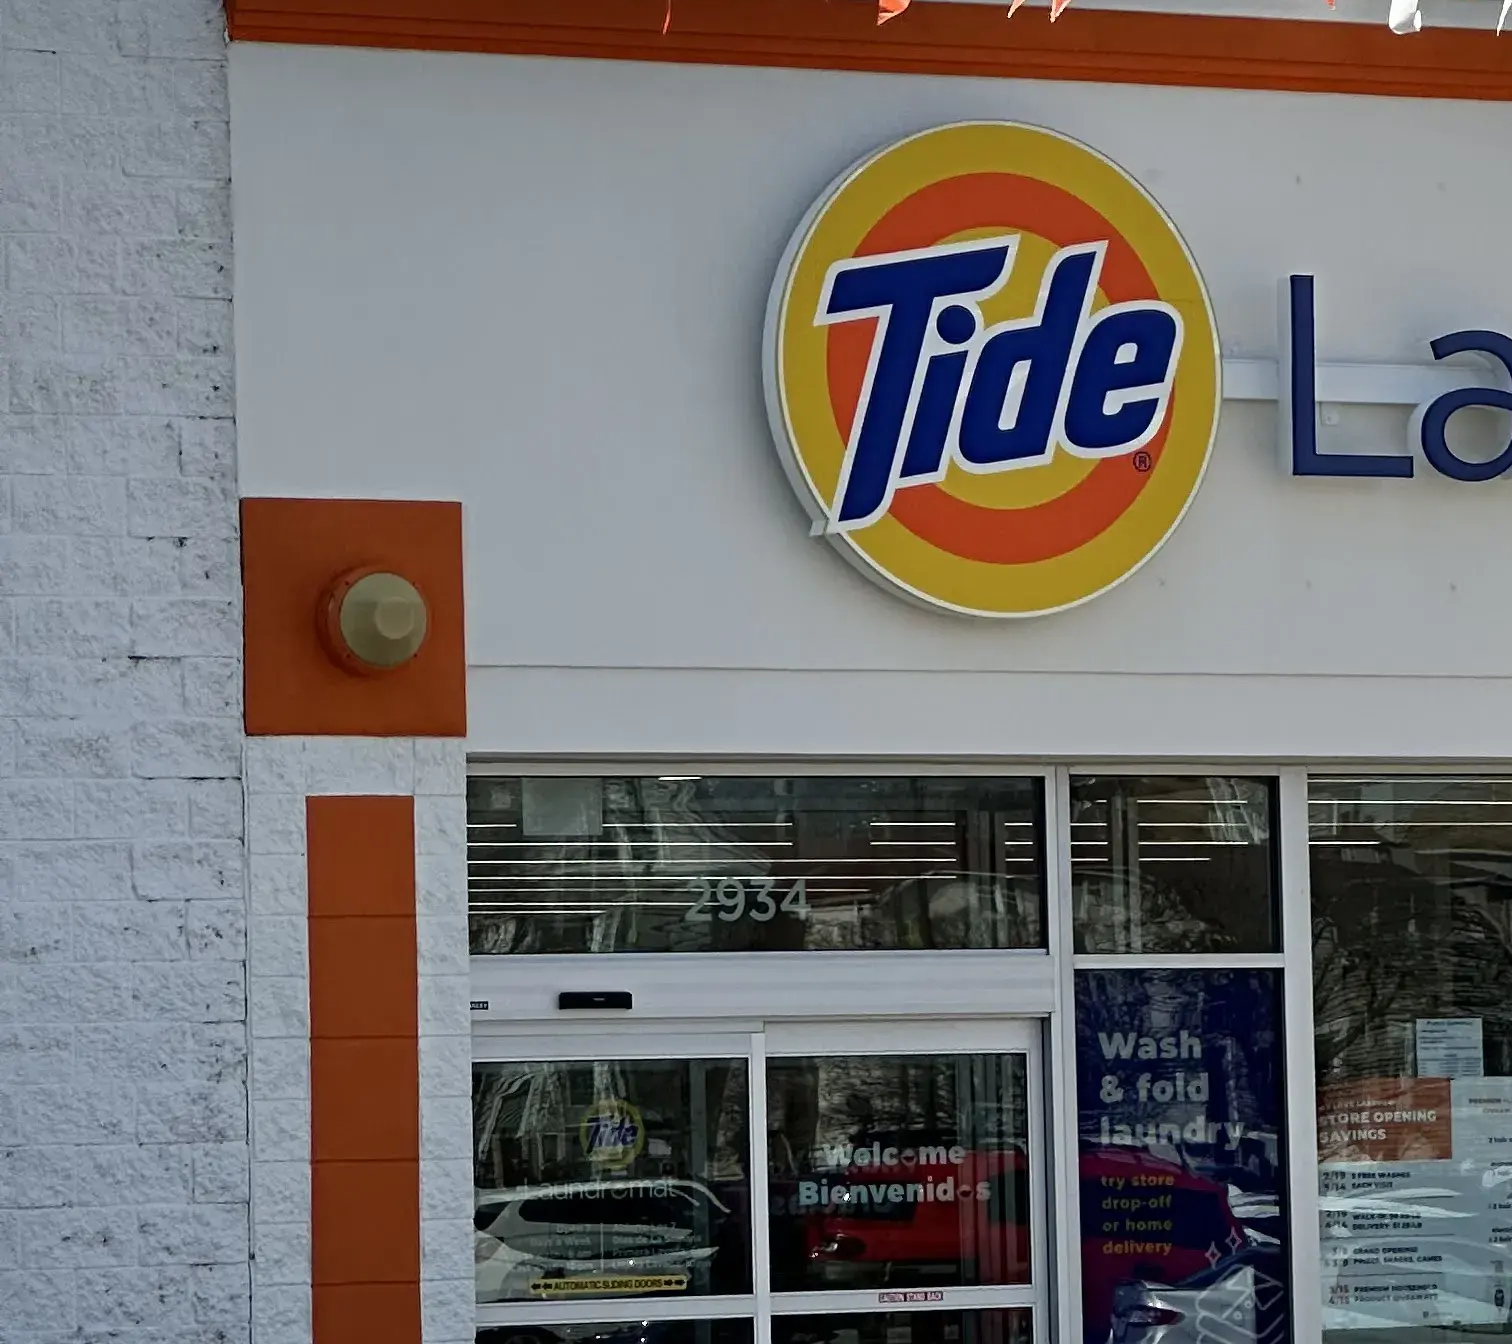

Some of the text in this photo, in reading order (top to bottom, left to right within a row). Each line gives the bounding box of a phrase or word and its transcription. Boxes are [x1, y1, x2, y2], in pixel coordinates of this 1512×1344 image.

[826, 244, 1177, 523] Tide
[684, 877, 812, 921] 2934
[1098, 1031, 1203, 1060] Wash
[1100, 1072, 1209, 1103] & fold
[1374, 1110, 1437, 1123] OPENING
[1100, 1116, 1244, 1150] laundry
[1320, 1129, 1387, 1143] SAVINGS
[822, 1142, 966, 1167] Welcome
[1101, 1174, 1175, 1191] try store
[1102, 1194, 1172, 1213] drop-off
[1103, 1218, 1173, 1232] or home
[1102, 1240, 1172, 1256] delivery
[634, 1278, 663, 1288] DOORS
